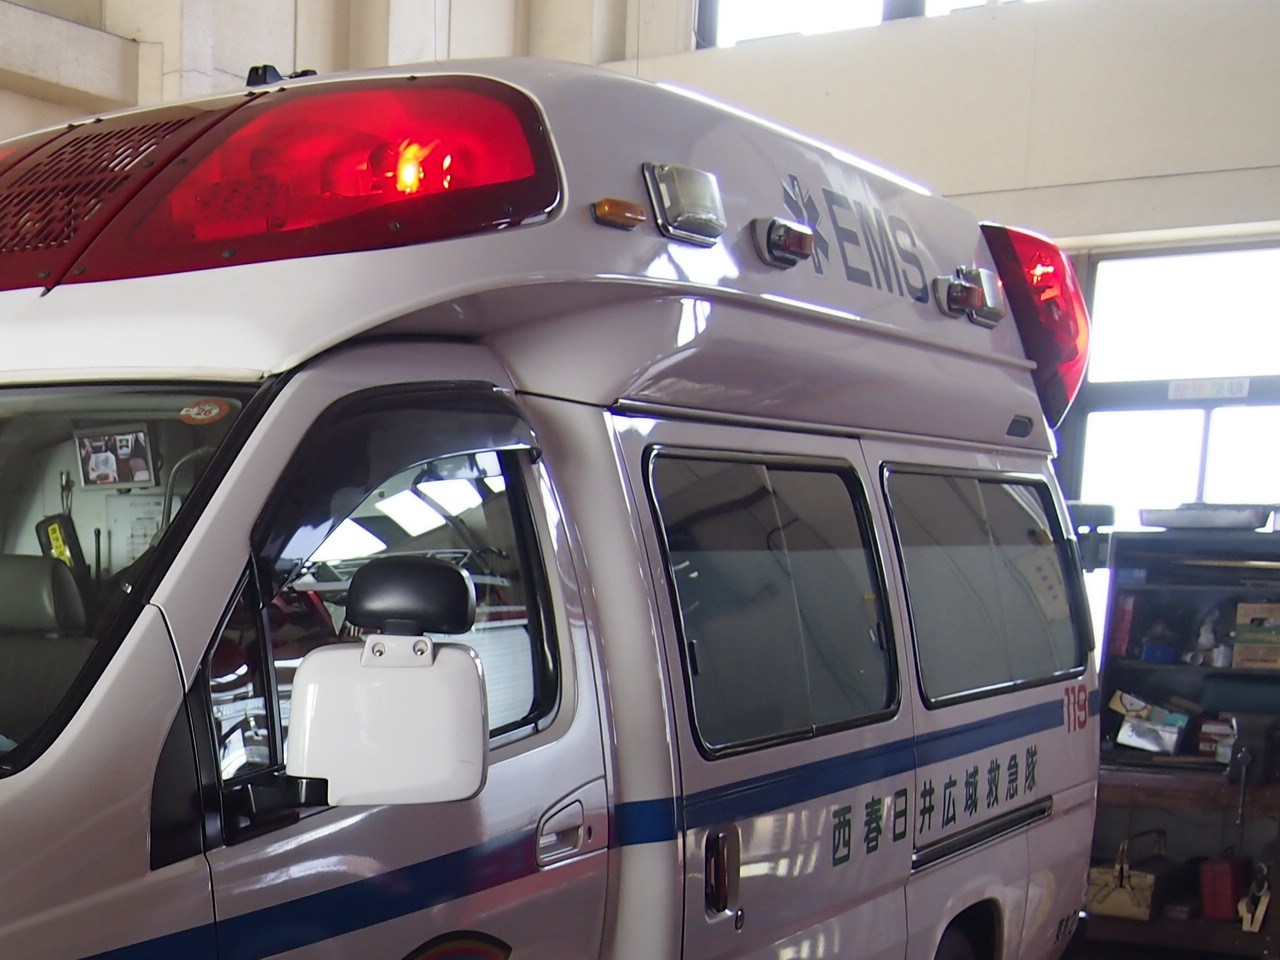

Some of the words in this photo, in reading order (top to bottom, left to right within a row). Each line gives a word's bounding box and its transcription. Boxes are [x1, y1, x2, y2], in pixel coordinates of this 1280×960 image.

[820, 187, 930, 304] EMS
[1064, 685, 1089, 733] 119
[831, 743, 1039, 868] 西春日井広域救急隊
